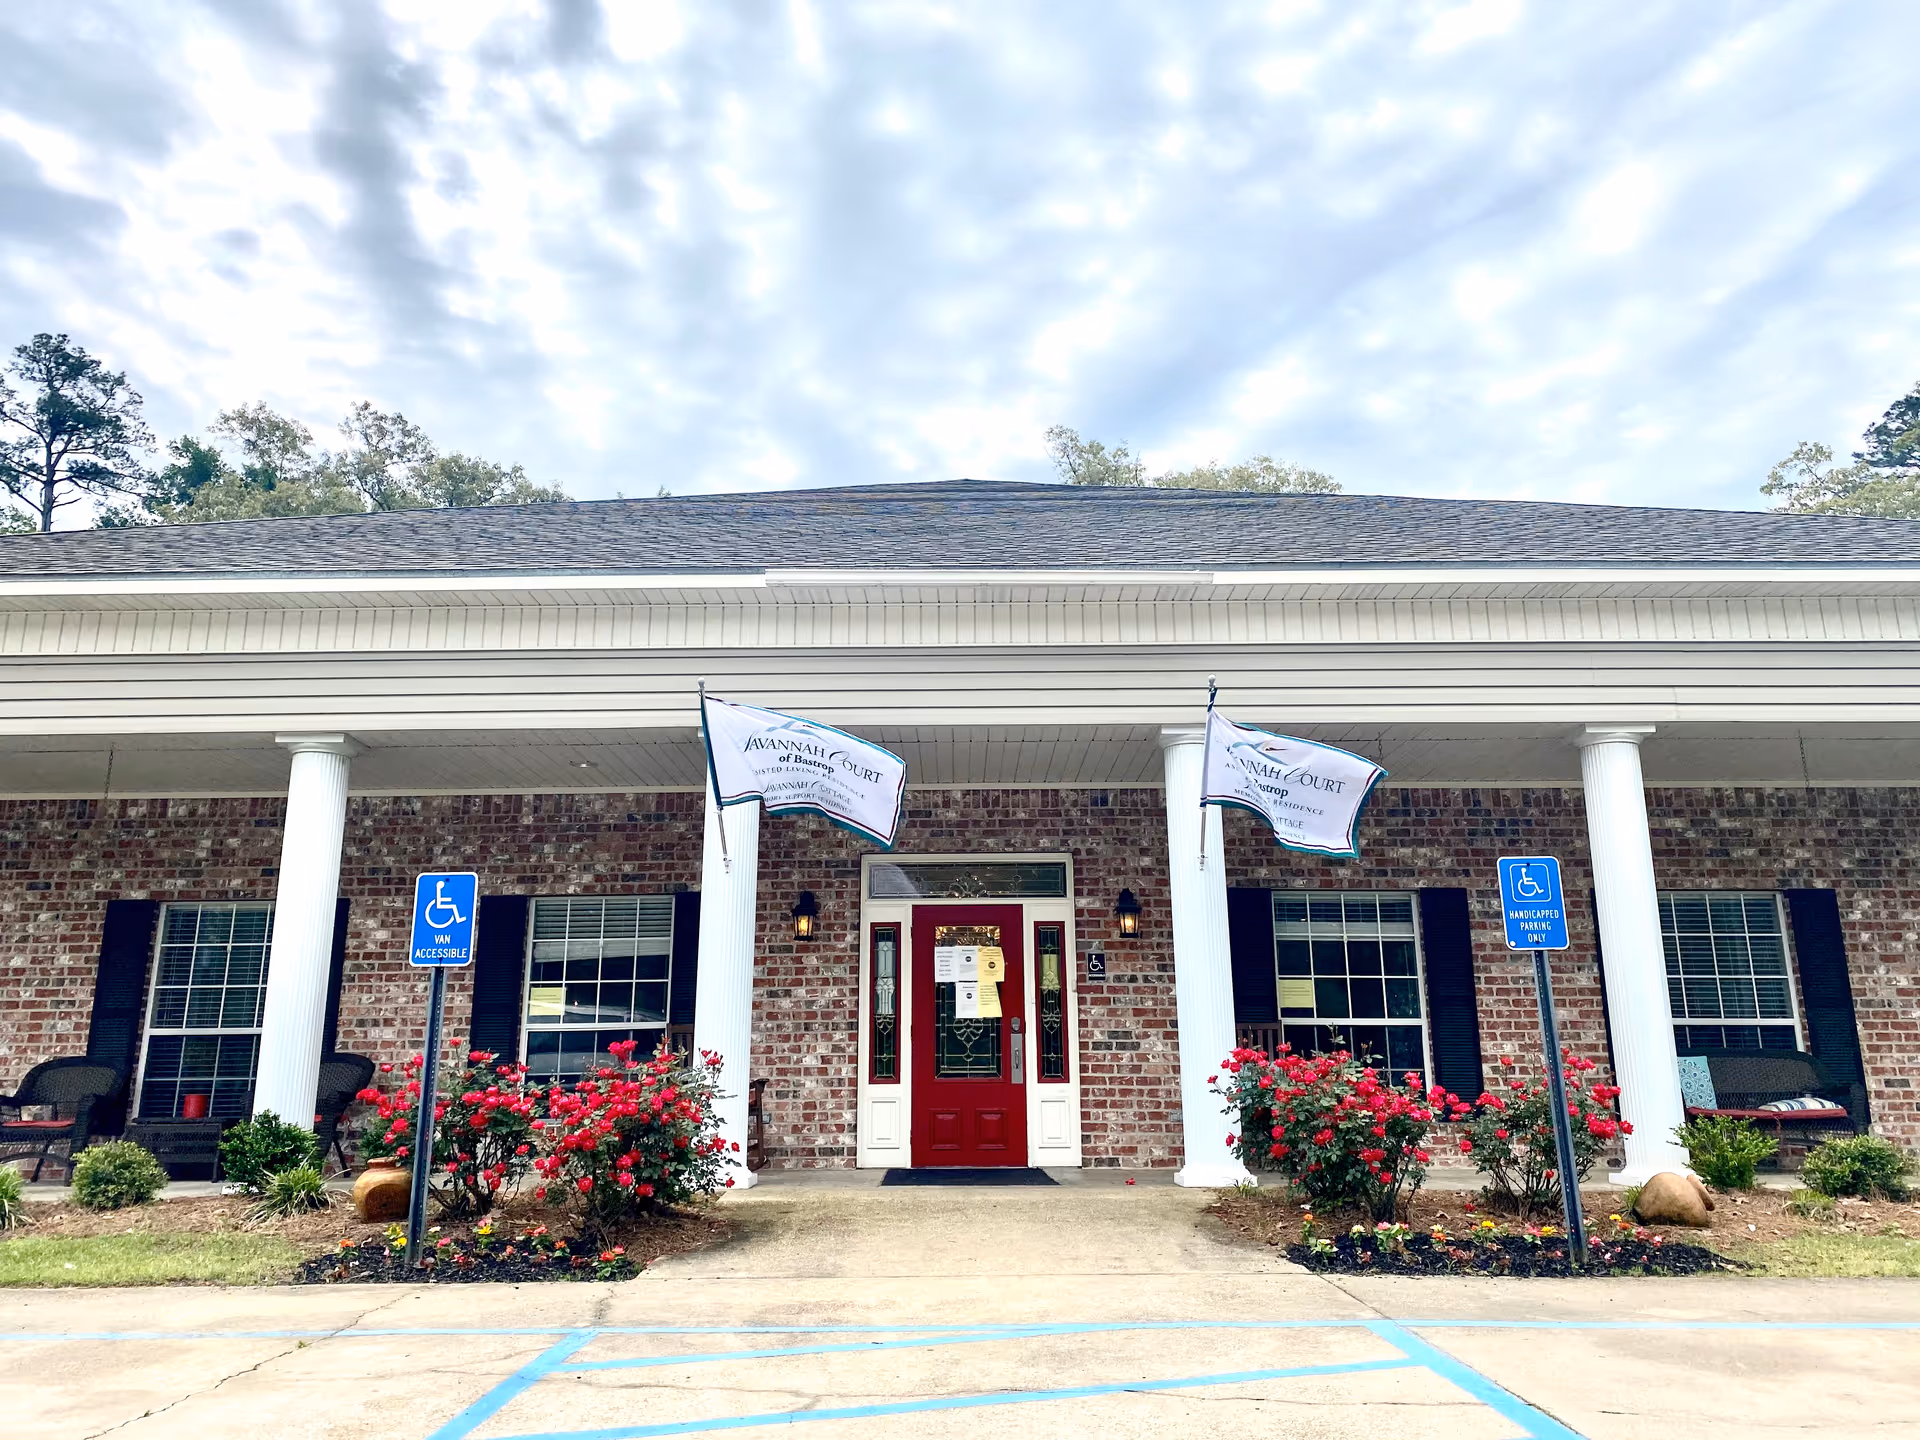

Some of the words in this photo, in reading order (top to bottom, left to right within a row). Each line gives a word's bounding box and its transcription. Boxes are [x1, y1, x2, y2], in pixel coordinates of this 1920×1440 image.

[778, 753, 793, 763] of
[793, 754, 835, 774] Bastrop
[828, 750, 884, 784] COURT
[786, 766, 819, 776] LIVING
[821, 772, 866, 801] RESIDENCE
[1283, 764, 1346, 794] COURT
[1273, 799, 1325, 816] RESIDENCE
[1509, 909, 1560, 920] HANDICAPPED
[1520, 921, 1552, 931] PARKING
[434, 934, 451, 945] VAN
[1527, 933, 1546, 943] ONLY
[414, 947, 468, 959] ACCESSIBLE
